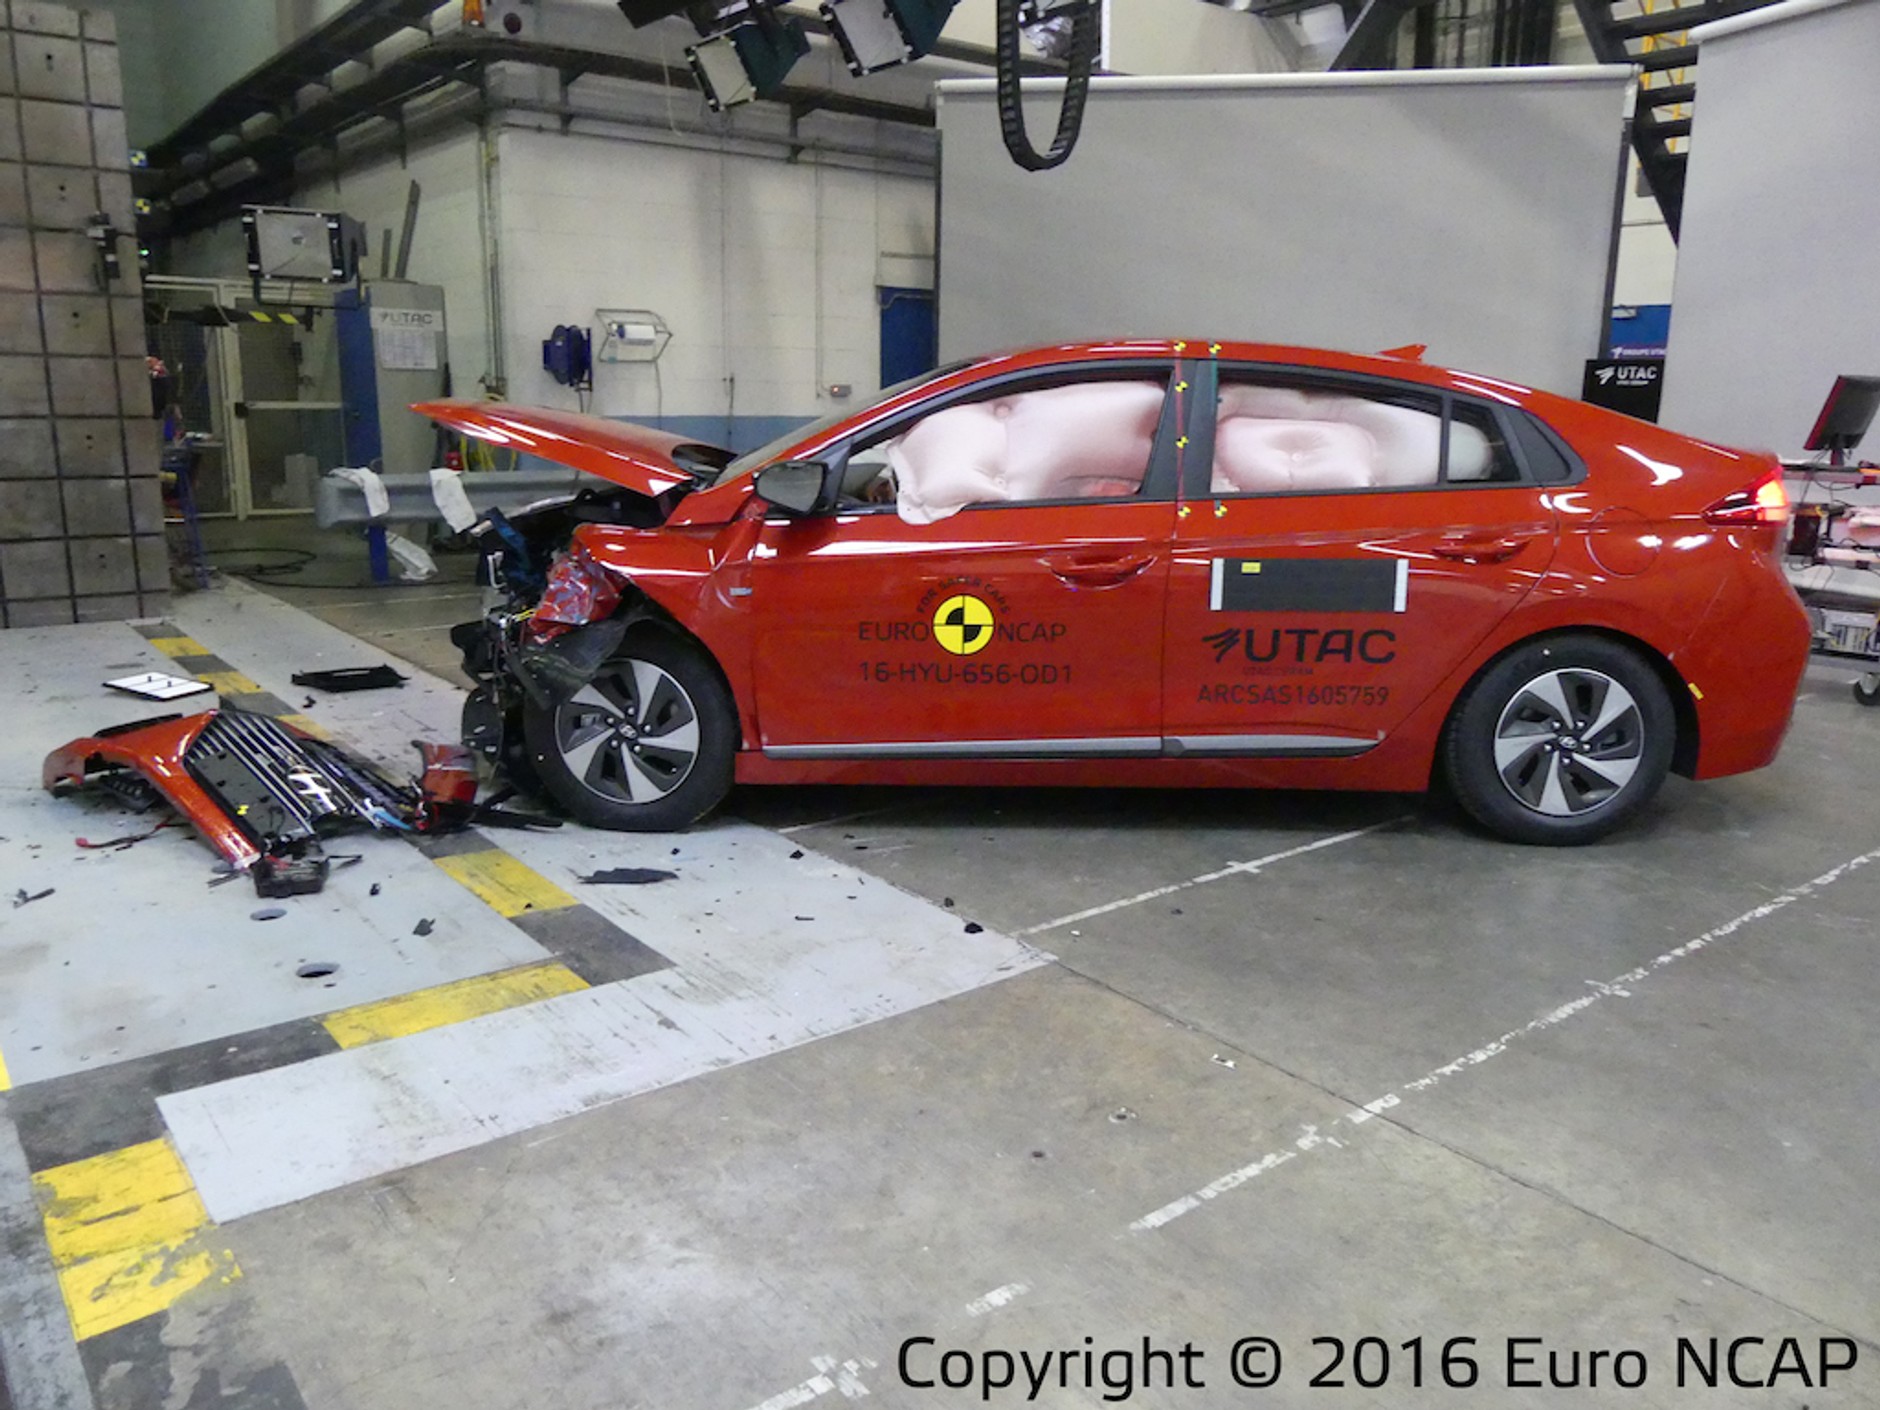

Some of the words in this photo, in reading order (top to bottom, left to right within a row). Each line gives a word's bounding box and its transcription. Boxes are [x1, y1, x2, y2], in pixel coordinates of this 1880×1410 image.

[1617, 366, 1657, 380] UTAC
[858, 621, 930, 641] EURO
[997, 623, 1067, 643] NCAP
[1245, 629, 1397, 664] UTAC
[1197, 684, 1390, 706] ARCSAS1605759
